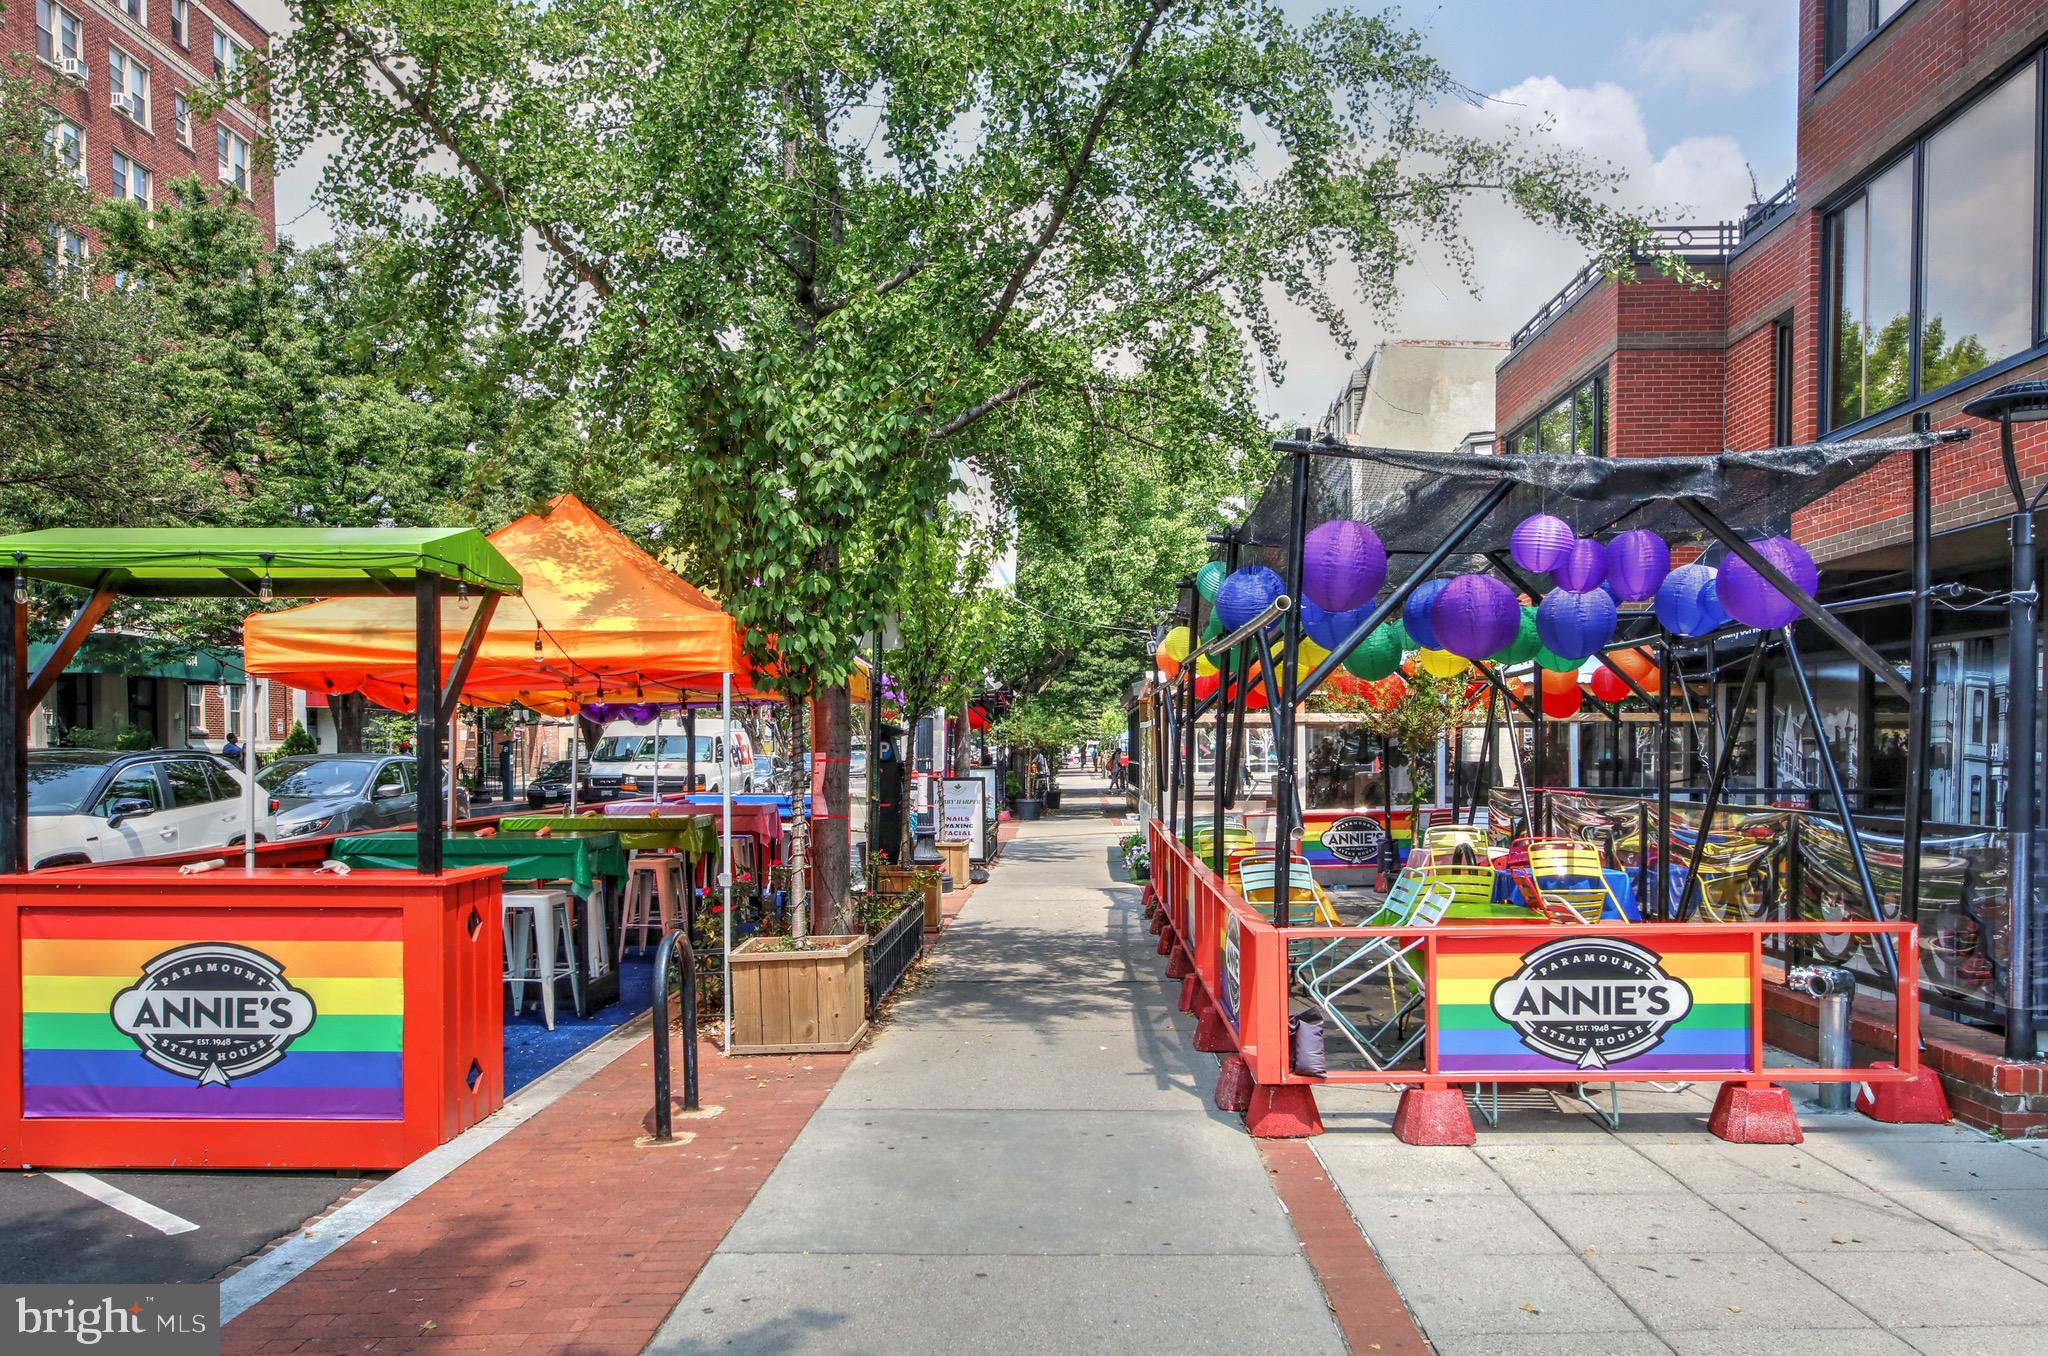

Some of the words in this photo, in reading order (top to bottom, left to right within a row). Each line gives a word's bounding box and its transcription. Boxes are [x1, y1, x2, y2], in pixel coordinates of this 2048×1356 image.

[160, 962, 266, 986] PARAMOUNT
[1539, 954, 1644, 976] PARAMOUNT
[1512, 985, 1670, 1016] ANNIE'S
[132, 997, 293, 1029] ANNIE'S
[1540, 1025, 1587, 1046] STEAK
[1595, 1025, 1644, 1046] HOUSE
[160, 1039, 209, 1061] STEAK
[217, 1039, 266, 1061] HOUSE
